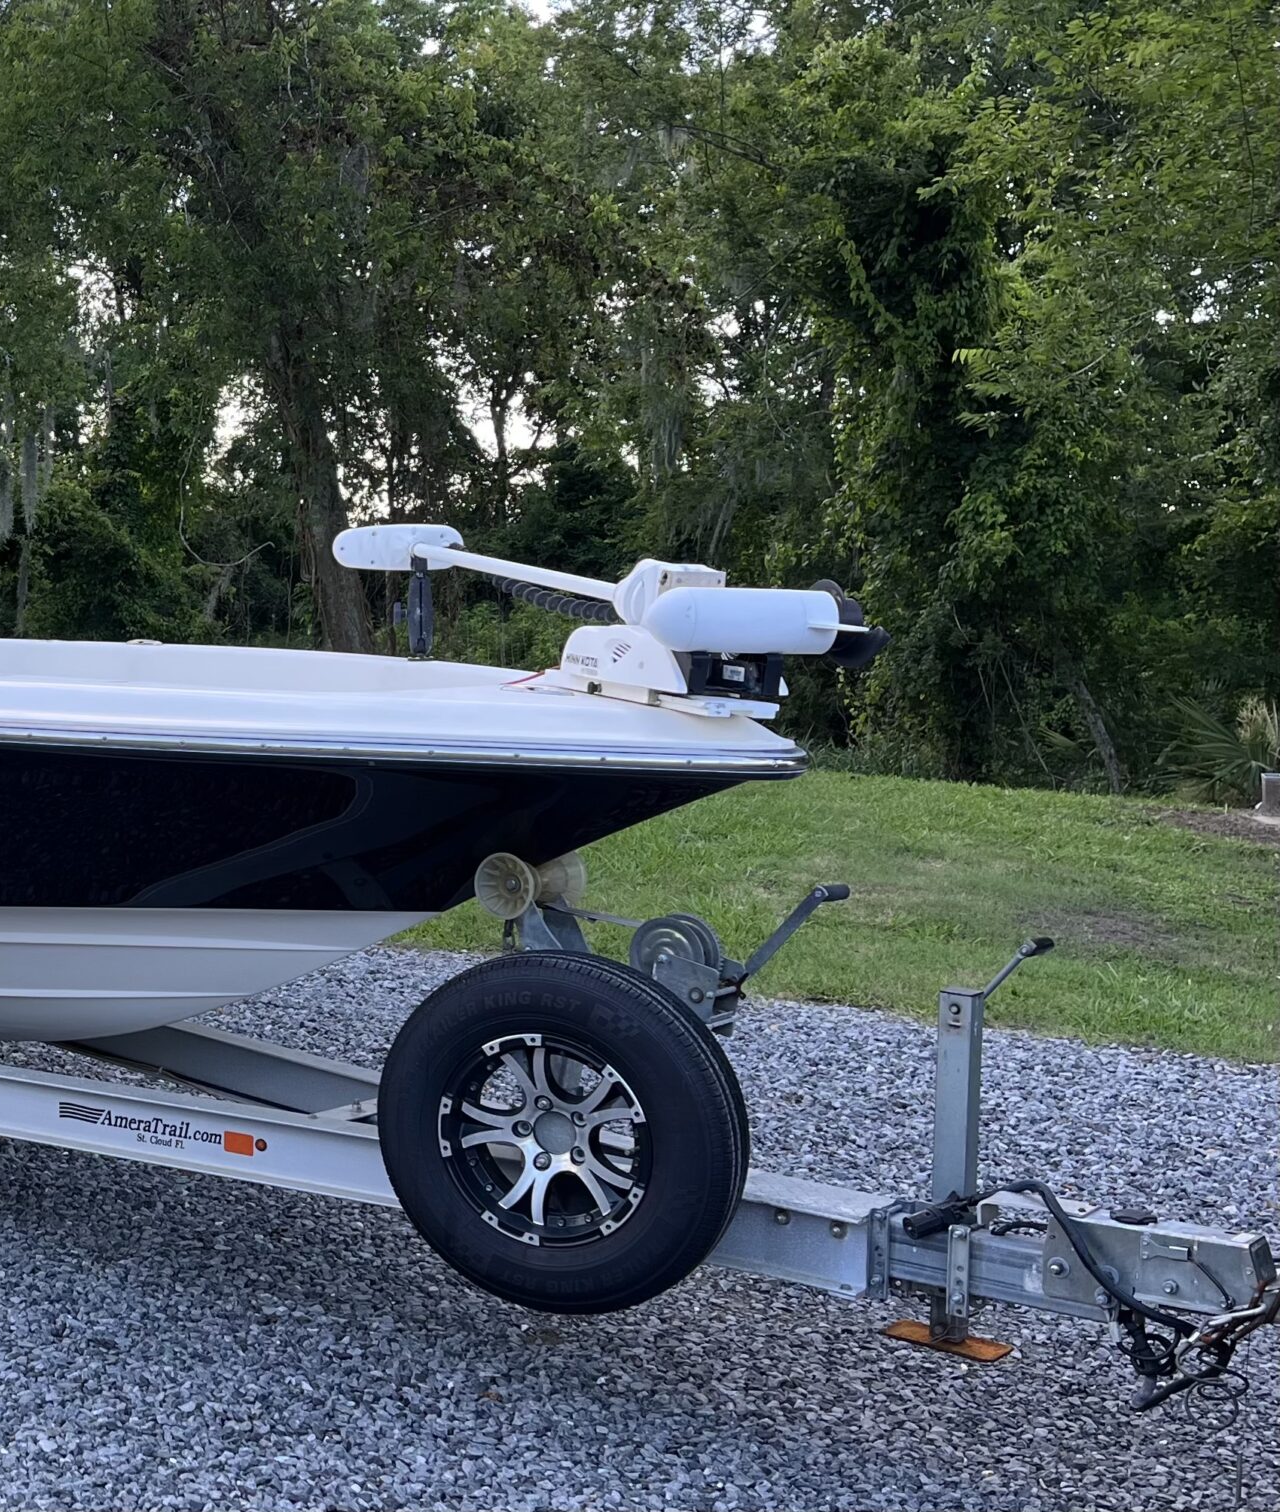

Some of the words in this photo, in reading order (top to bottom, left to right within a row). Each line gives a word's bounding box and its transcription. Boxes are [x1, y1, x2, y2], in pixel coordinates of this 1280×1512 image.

[483, 990, 532, 1010] KING
[540, 992, 582, 1013] RST
[101, 1110, 222, 1145] AmeraTrail.com
[150, 1135, 172, 1147] Cloud
